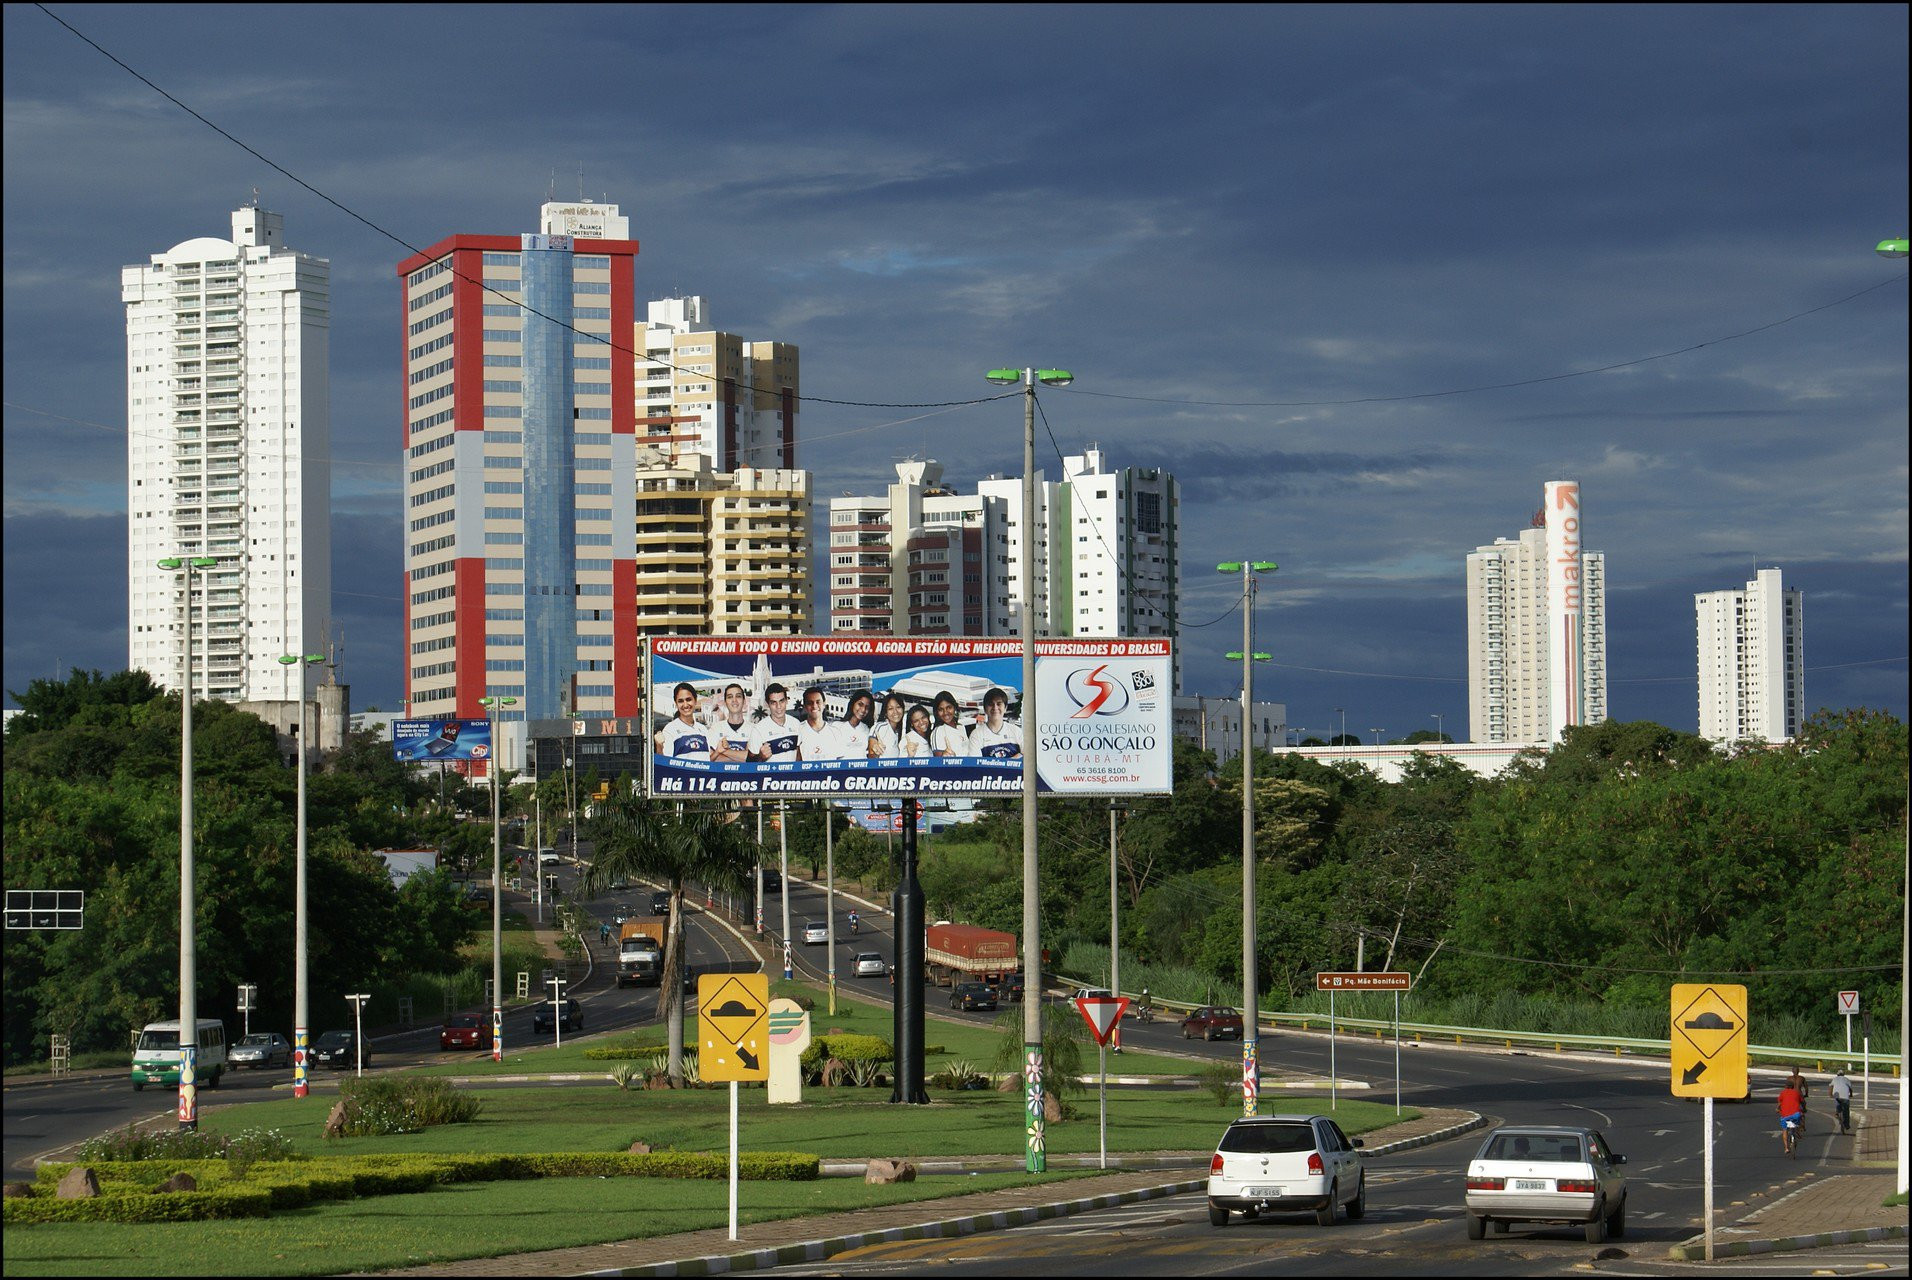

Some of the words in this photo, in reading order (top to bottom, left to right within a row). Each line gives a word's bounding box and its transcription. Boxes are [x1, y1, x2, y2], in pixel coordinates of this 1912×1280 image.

[657, 640, 736, 653] COMPLETARAM
[739, 641, 767, 653] TODO
[771, 641, 778, 653] O
[781, 641, 819, 653] ENSINO
[822, 641, 873, 653] CONOSCO.
[876, 642, 913, 653] AGORA
[915, 640, 947, 653] ESTÃO
[950, 642, 970, 653] NAS
[1034, 643, 1107, 655] NIVERSIDADES
[1110, 643, 1126, 655] DO
[1128, 643, 1167, 655] BRASIL.
[1040, 721, 1091, 735] COLÉGIO
[1095, 723, 1156, 734] SALESIANO
[1042, 734, 1073, 751] SÃO
[1077, 736, 1155, 753] GONÇALO
[661, 777, 683, 791] Há
[689, 777, 717, 791] 114
[720, 780, 758, 791] anos
[762, 776, 840, 791] Formando
[844, 776, 916, 791] GRANDES
[919, 775, 1024, 791] Personalidad
[1063, 774, 1140, 784] www.cssg.com.br
